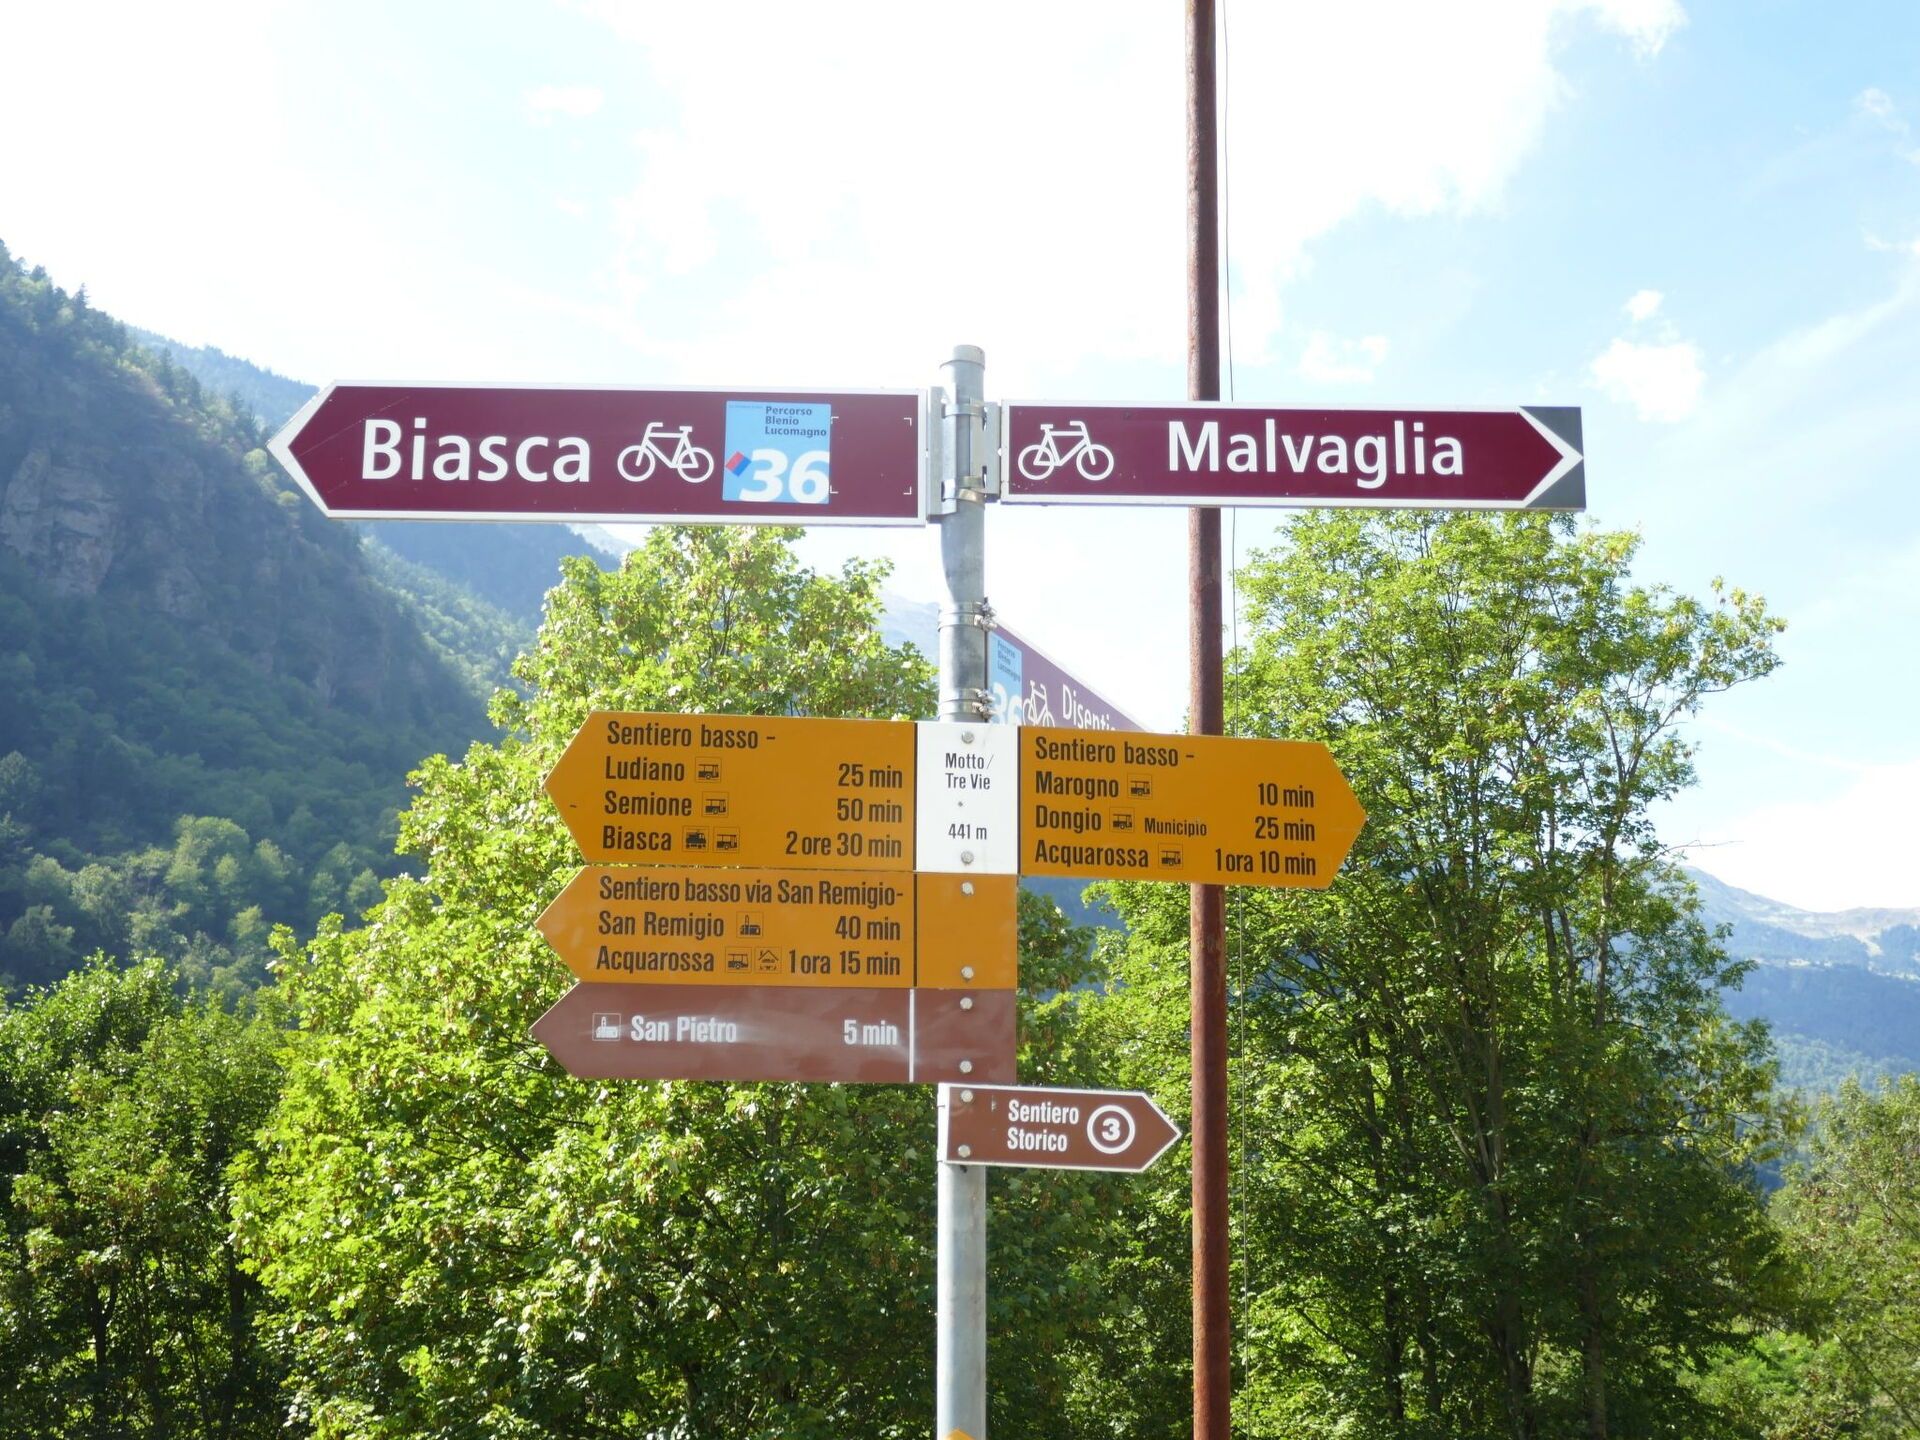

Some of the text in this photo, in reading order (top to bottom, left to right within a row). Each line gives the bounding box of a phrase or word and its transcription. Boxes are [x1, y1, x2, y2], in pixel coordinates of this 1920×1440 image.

[765, 405, 813, 416] Percorso
[765, 415, 800, 426] Blenio
[764, 426, 827, 438] Lucomagno
[361, 417, 591, 483] Biasca
[1167, 418, 1464, 489] Malvaglia
[739, 448, 830, 504] 36
[1062, 683, 1116, 731] Disenti
[607, 720, 692, 748] Sentiero
[700, 724, 759, 750] basso
[1035, 736, 1116, 763] Sentiero
[1124, 741, 1179, 767] basso
[605, 755, 903, 789] Ludiano 25 min
[945, 772, 991, 790] Tre Vie
[1035, 770, 1315, 808] Marogno 10 min
[604, 790, 903, 823] Semione 50 min
[948, 823, 988, 840] 441 m
[1035, 805, 1316, 842] Dongio Municipio 25 min
[602, 825, 902, 858] Biasca 2 ore 30 min
[1035, 839, 1317, 876] Acquarossa 1 ora 10 min
[599, 875, 680, 901] Sentiero
[684, 876, 740, 903] basso
[745, 880, 772, 903] via
[777, 879, 813, 905] San
[598, 911, 901, 941] San Remigio 40 min
[596, 945, 901, 976] Acquarossa 1 ora 15 min
[630, 1014, 898, 1046] San Pietro 5 min
[1008, 1098, 1080, 1125] Sentiero
[1007, 1126, 1068, 1152] Storico
[1101, 1117, 1121, 1142] 3
